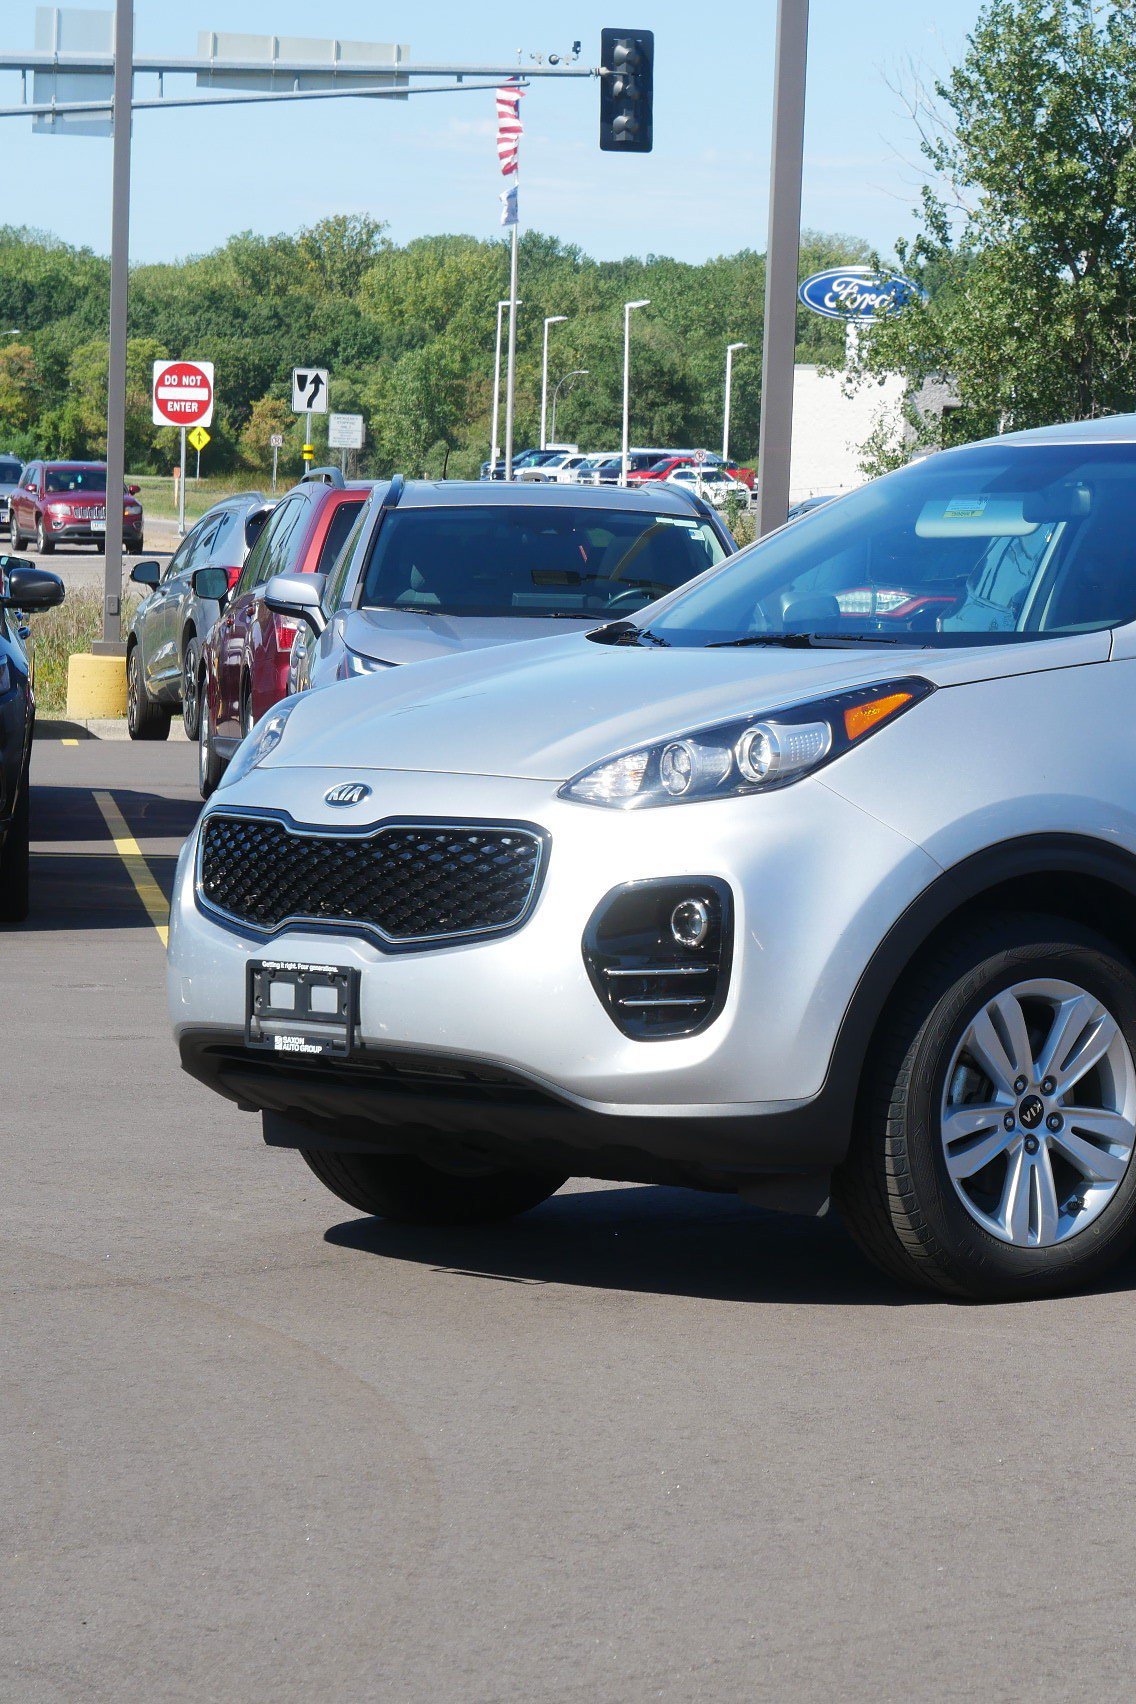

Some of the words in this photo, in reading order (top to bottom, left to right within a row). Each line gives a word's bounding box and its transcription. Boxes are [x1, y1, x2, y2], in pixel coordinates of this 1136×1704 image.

[823, 277, 898, 310] Ford
[164, 374, 179, 386] DO
[182, 375, 202, 386] NOT
[167, 401, 199, 413] ENTER
[327, 785, 364, 802] KIA
[262, 960, 280, 970] Getting
[282, 1035, 304, 1045] SAXON
[283, 1043, 300, 1052] AUTO
[300, 1045, 322, 1054] GROUP
[1022, 1099, 1043, 1123] KIA
